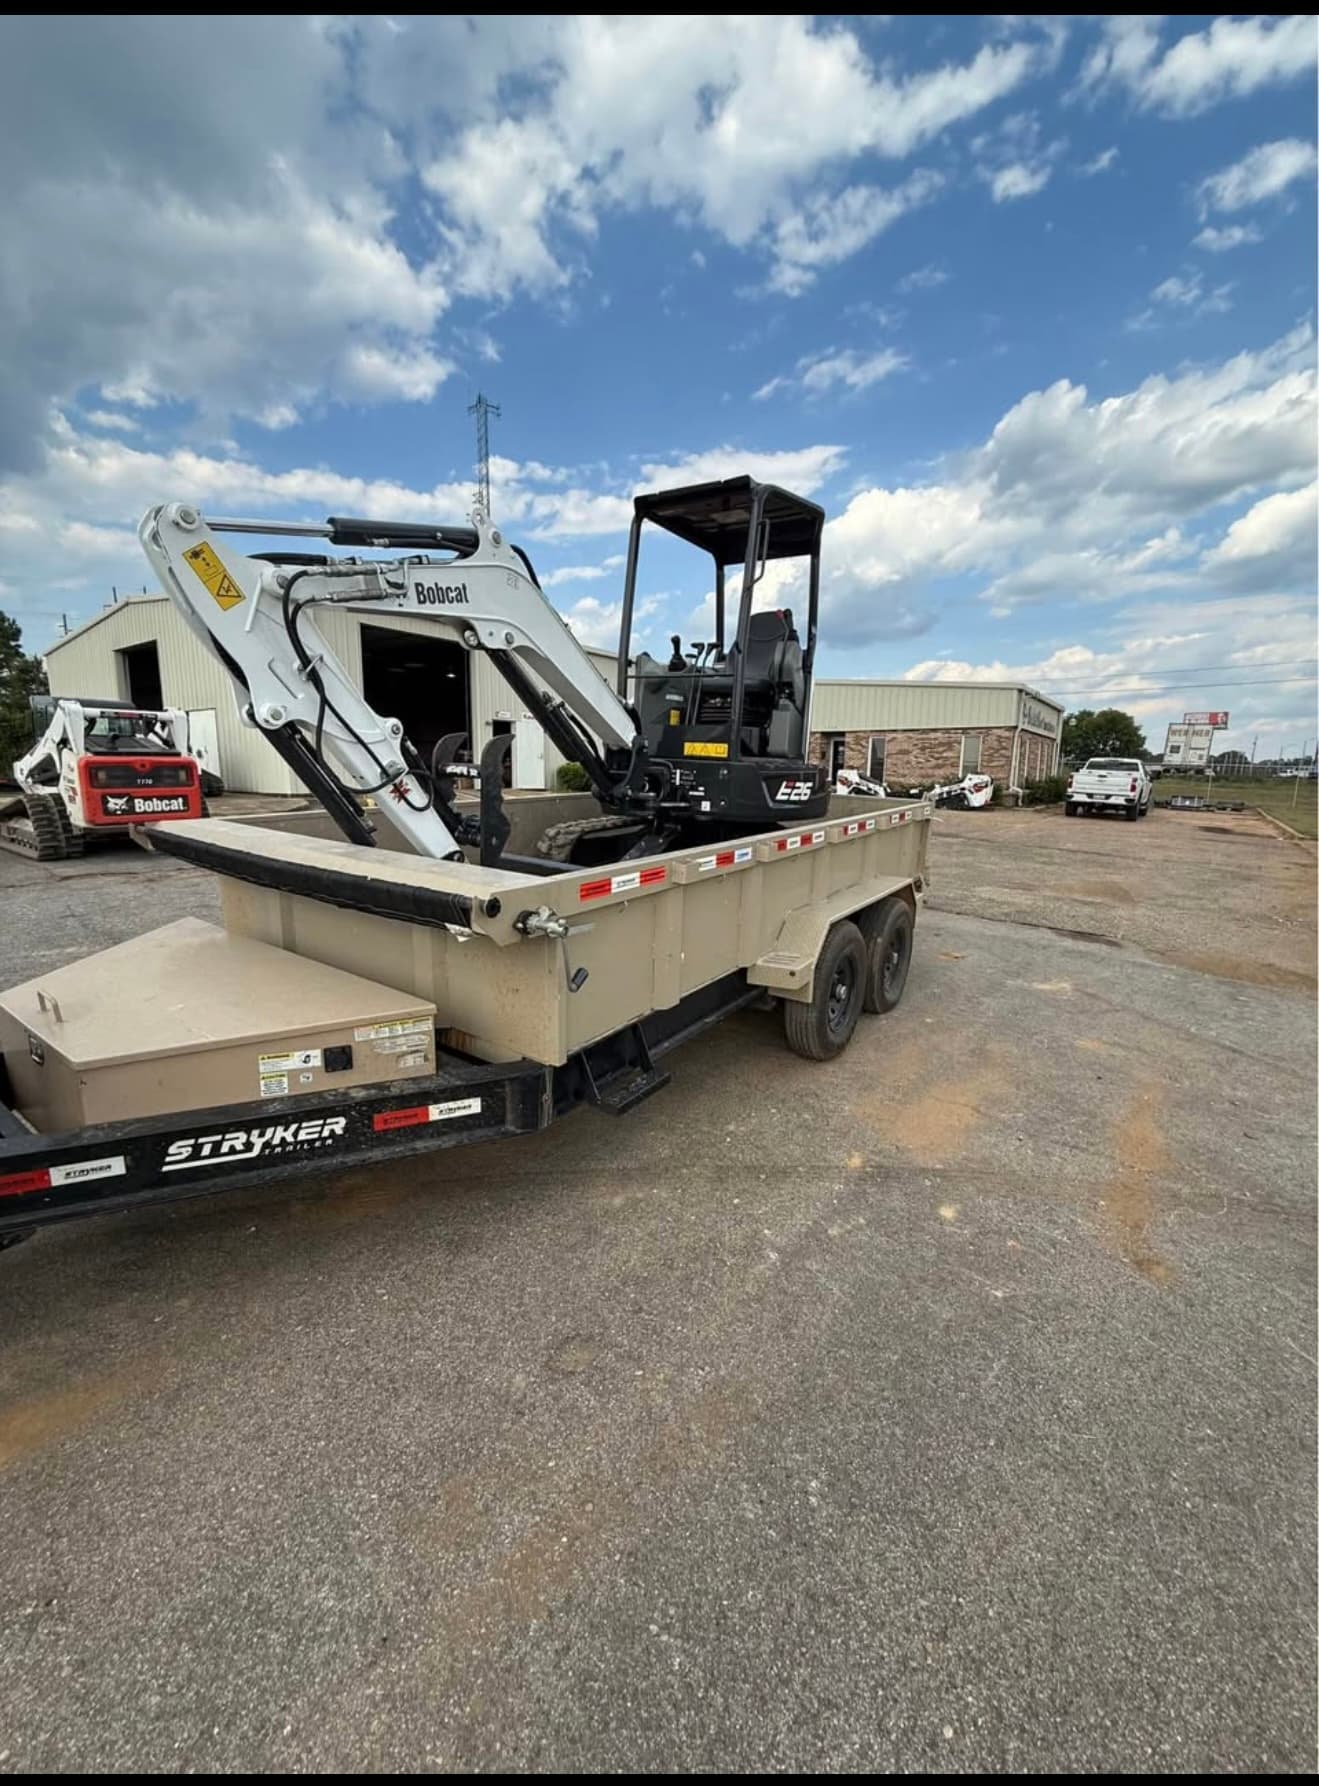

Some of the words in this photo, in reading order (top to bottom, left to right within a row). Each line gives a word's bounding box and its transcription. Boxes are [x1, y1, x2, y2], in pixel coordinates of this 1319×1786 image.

[414, 581, 469, 605] Bobcat
[134, 797, 185, 813] Bobcat
[161, 1116, 347, 1172] STRYKER
